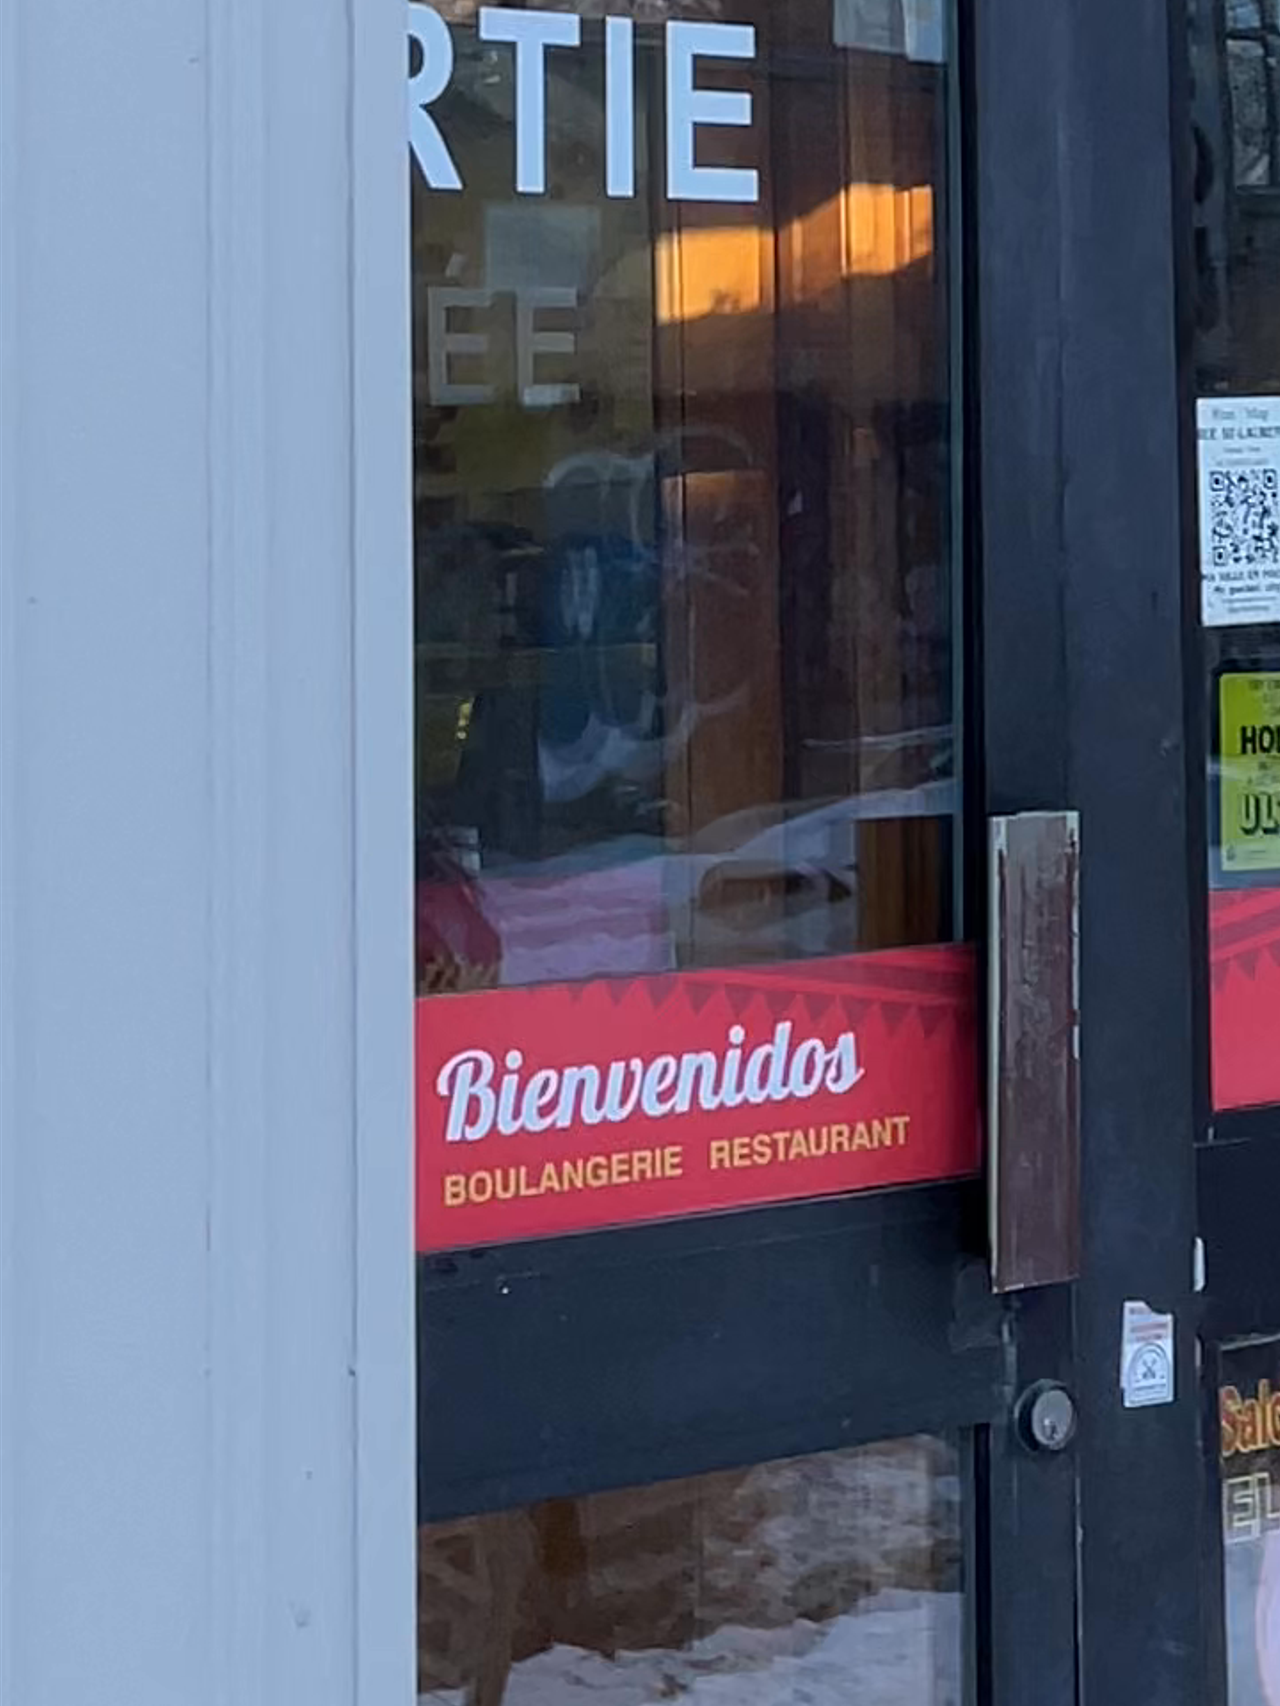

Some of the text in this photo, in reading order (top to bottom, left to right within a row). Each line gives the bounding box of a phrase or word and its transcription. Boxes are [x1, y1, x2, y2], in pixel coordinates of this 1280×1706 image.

[436, 1020, 866, 1142] Bienvenidos
[444, 1115, 911, 1208] BOULANGERIE RESTAURANT
[1222, 1471, 1280, 1544] EL
